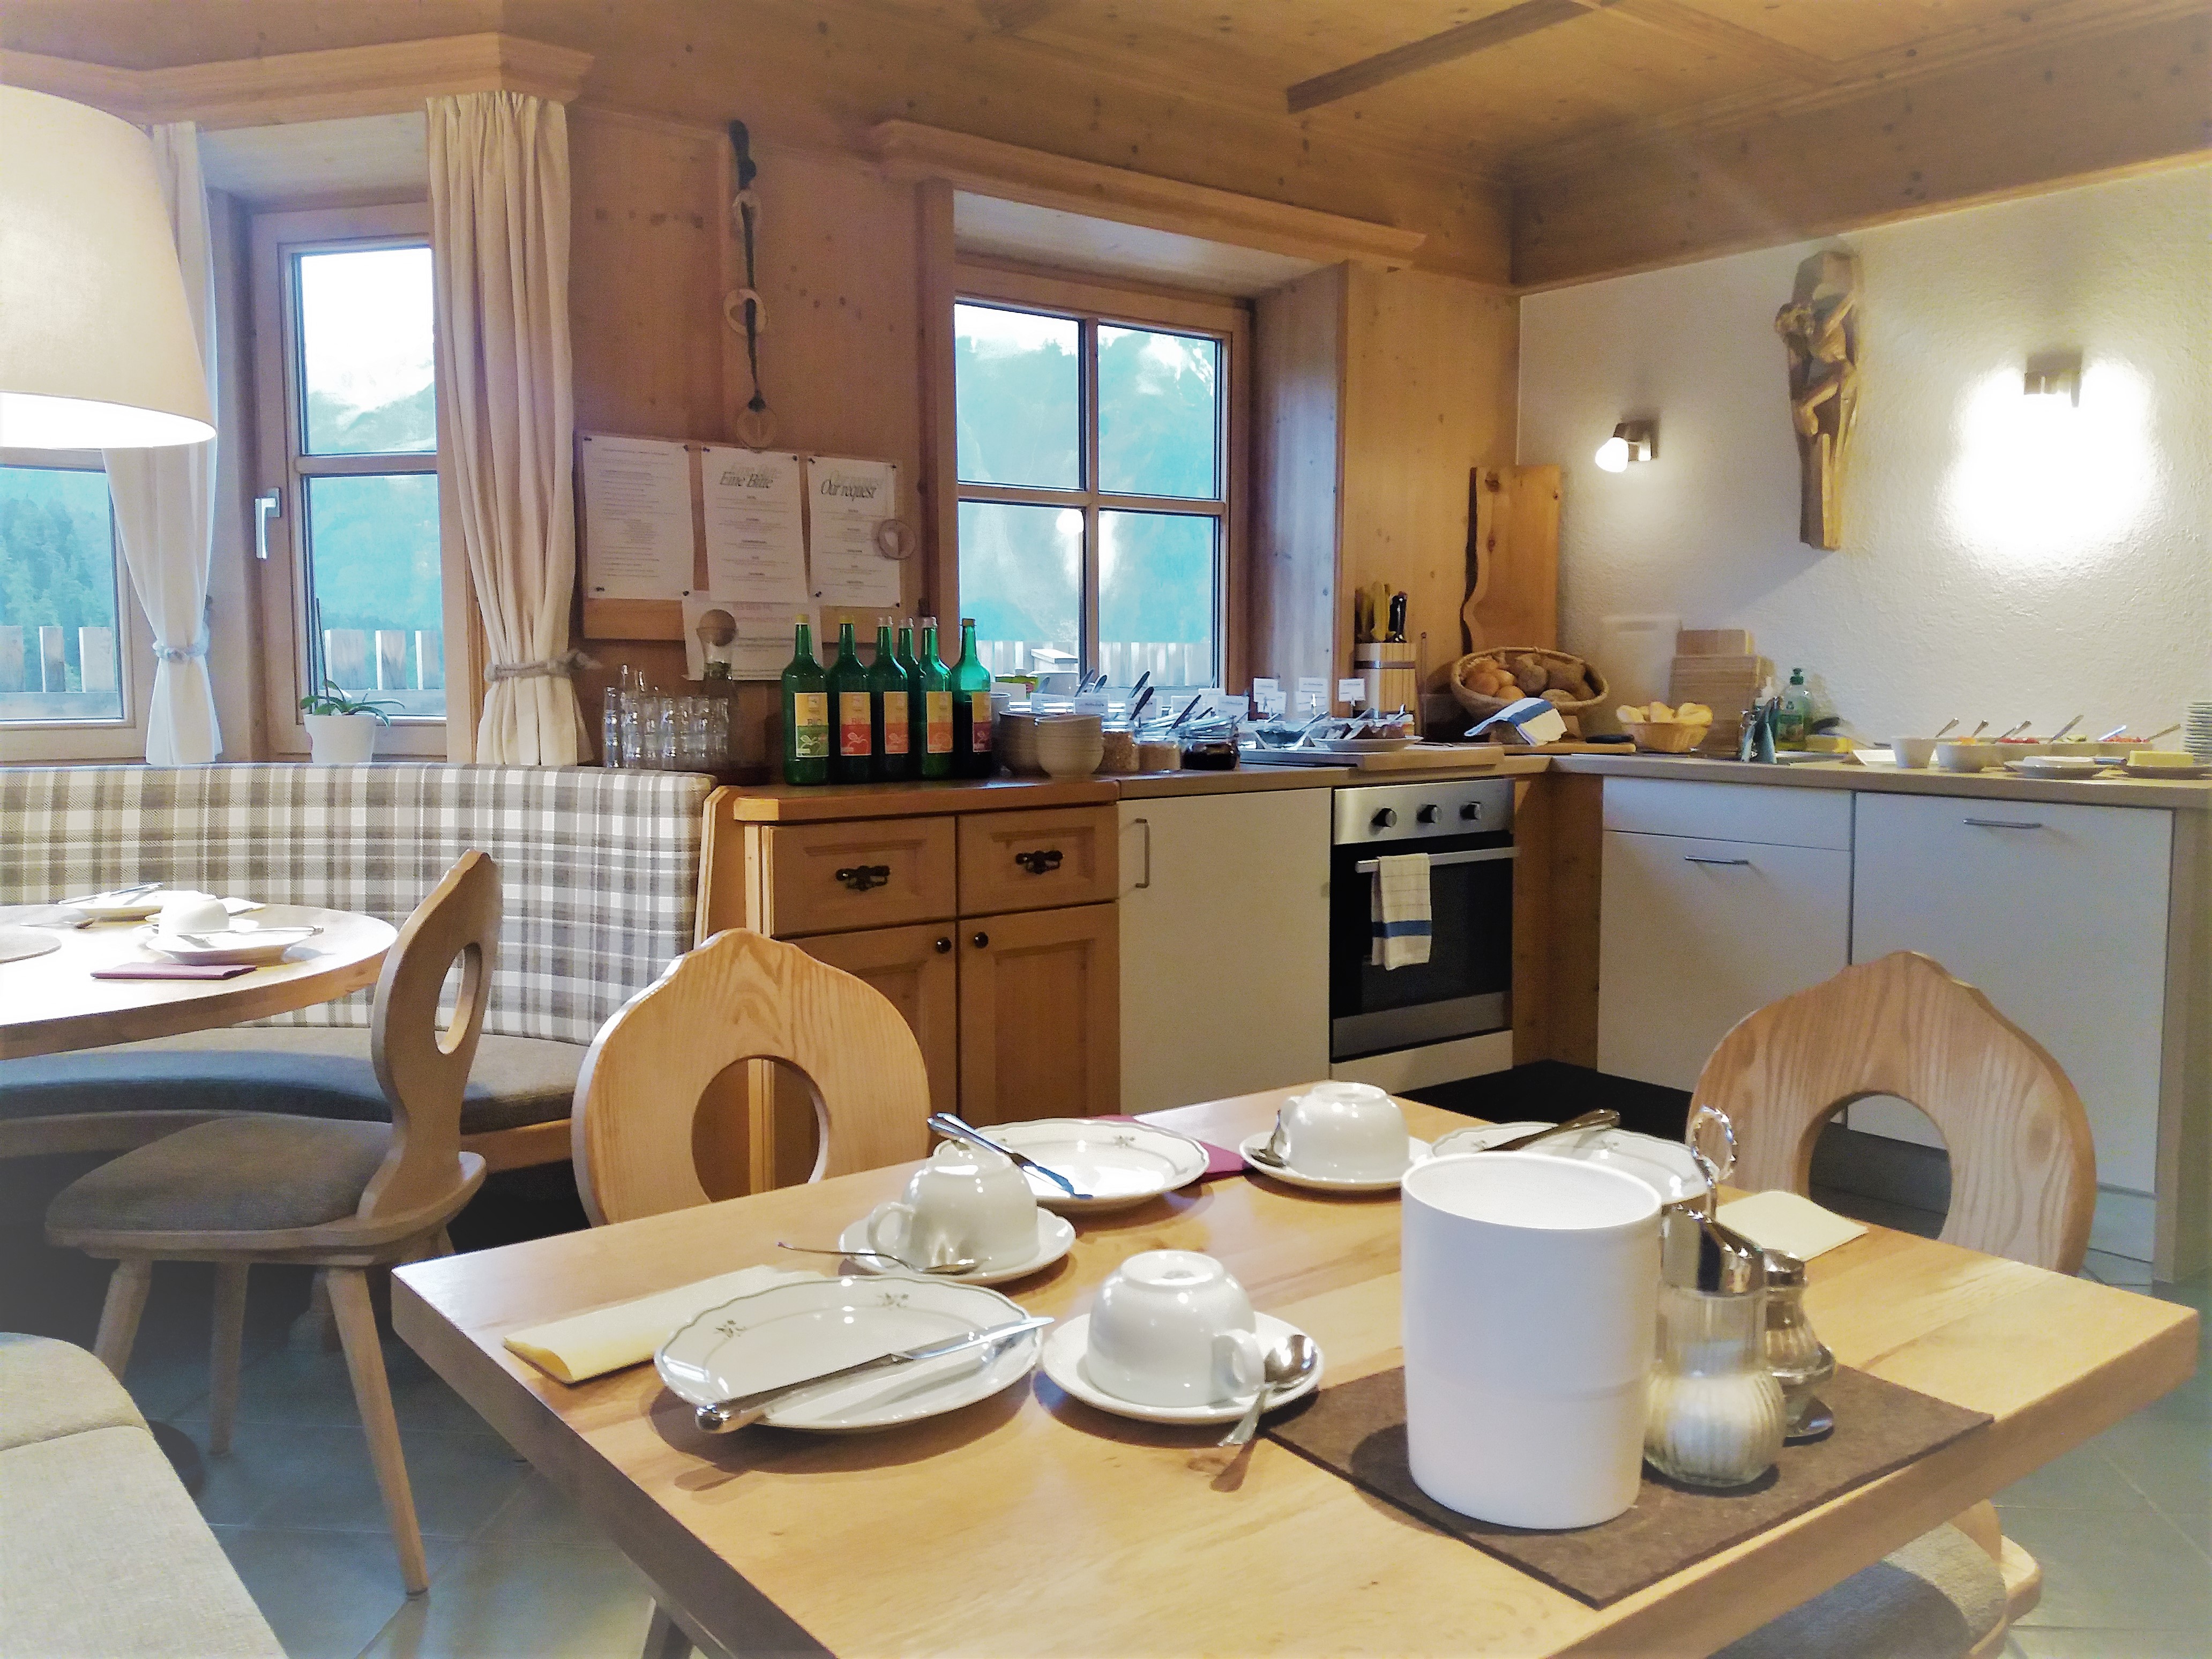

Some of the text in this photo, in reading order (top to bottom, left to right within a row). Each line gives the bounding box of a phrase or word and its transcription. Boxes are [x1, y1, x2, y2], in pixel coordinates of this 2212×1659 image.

[746, 473, 773, 489] Bitte
[821, 479, 877, 502] Our request
